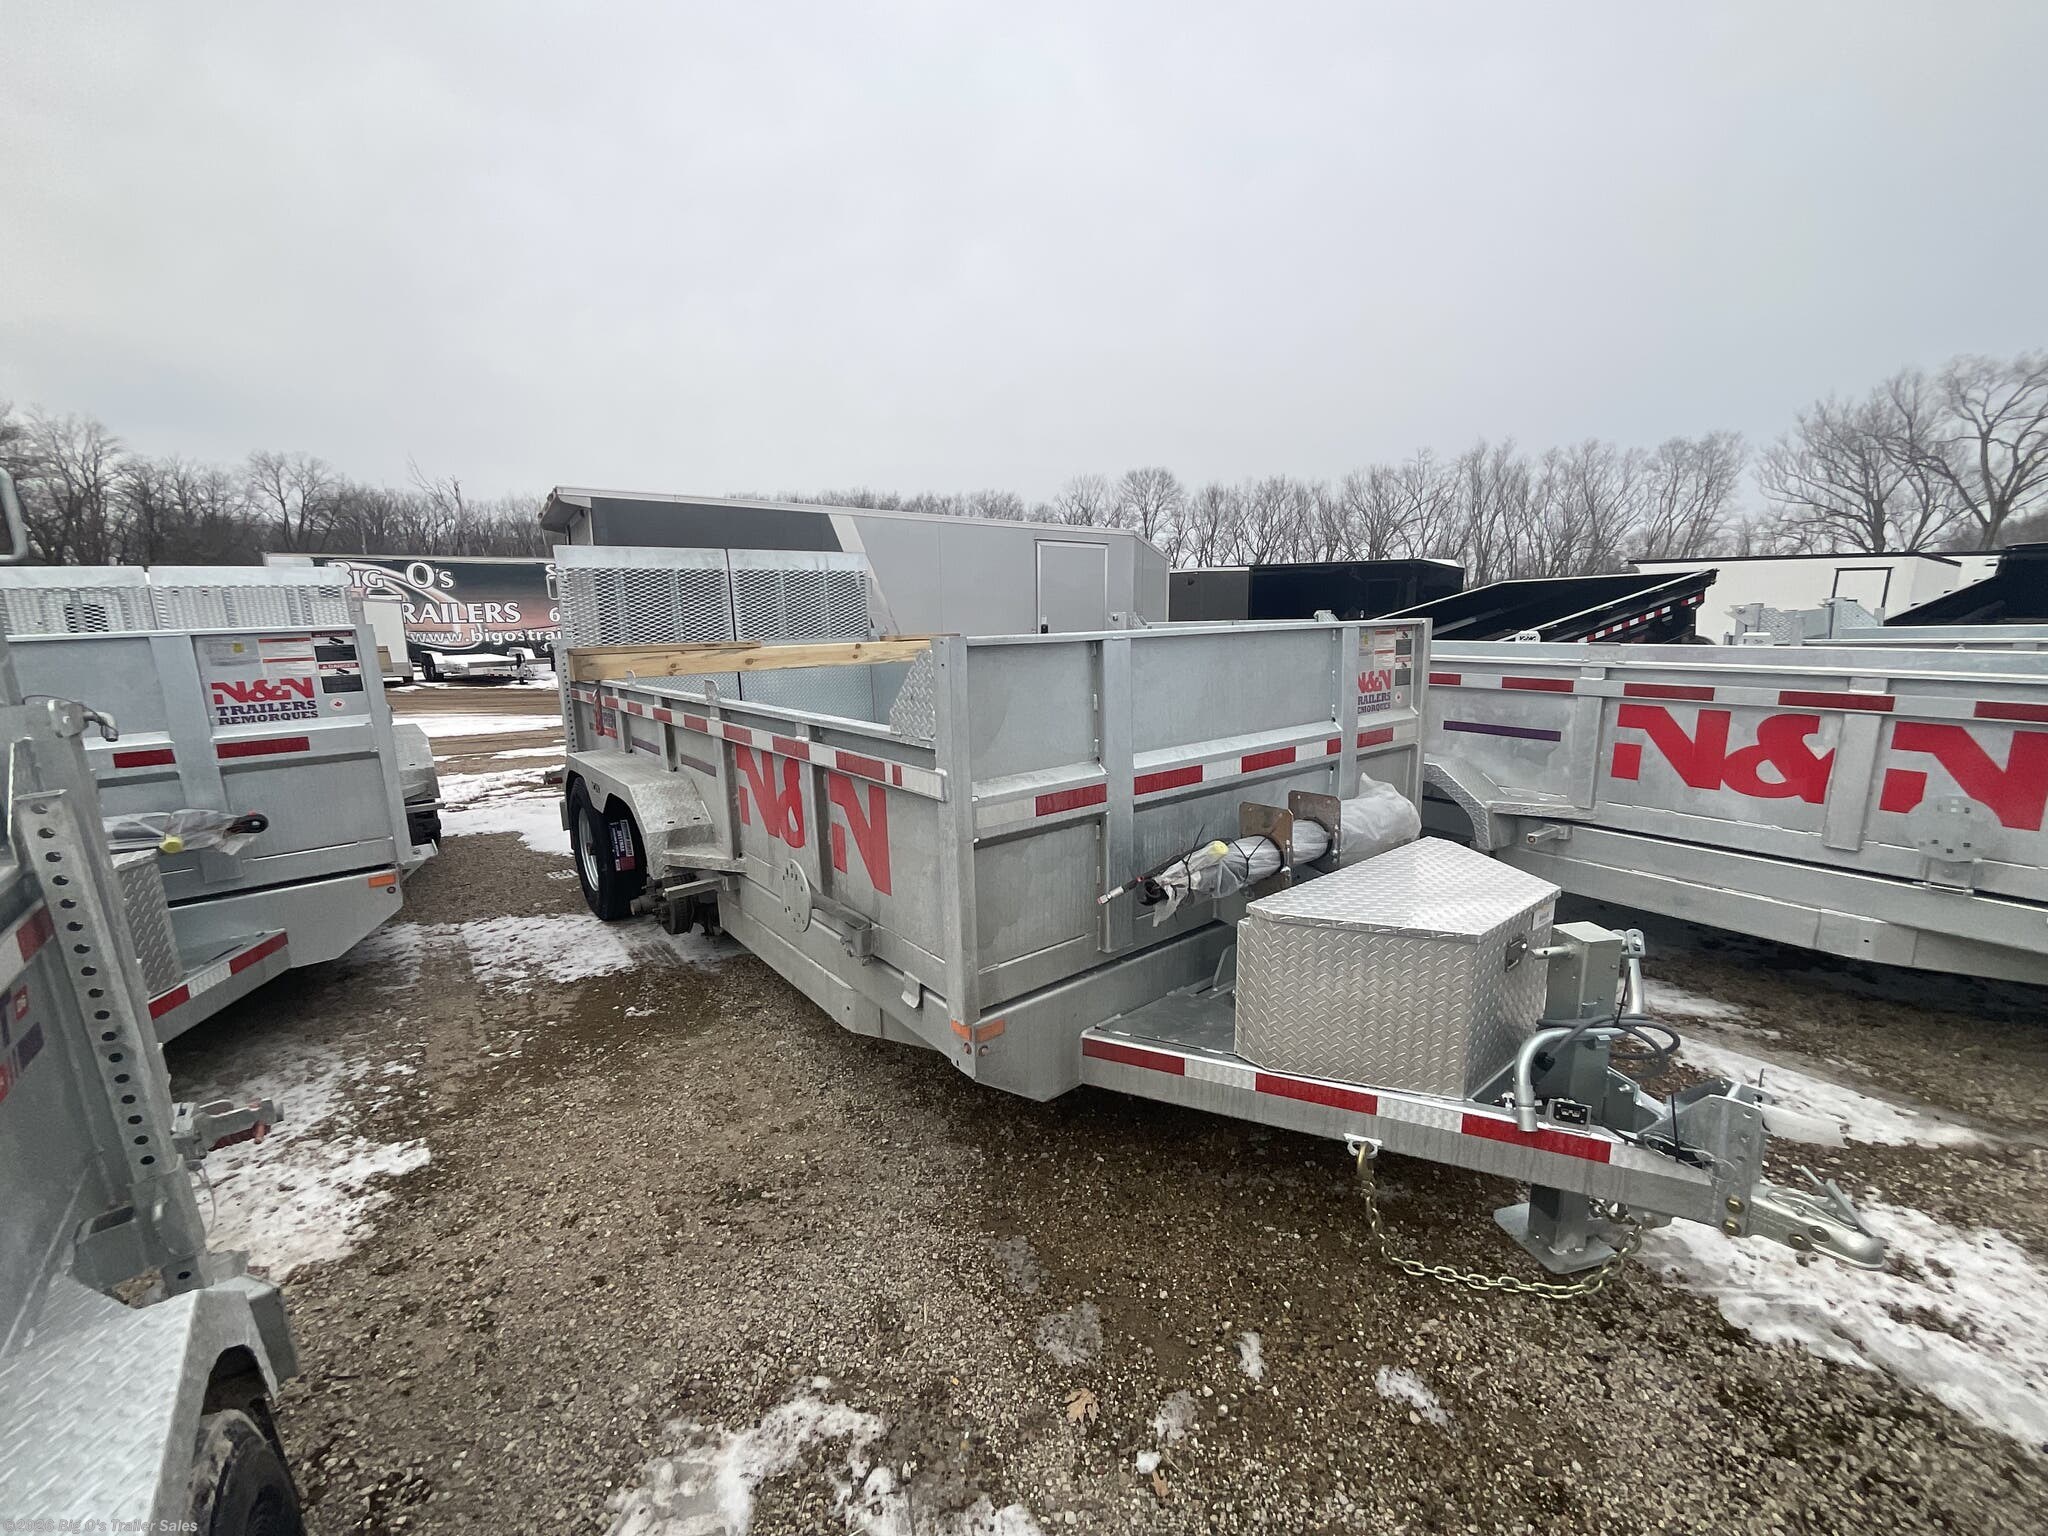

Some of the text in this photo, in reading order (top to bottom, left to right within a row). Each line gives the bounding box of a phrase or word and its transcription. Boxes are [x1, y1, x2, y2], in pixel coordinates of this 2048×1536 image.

[368, 594, 521, 625] RAILERS
[410, 628, 563, 645] www.bigostrai
[211, 677, 315, 705] N&N
[1358, 692, 1391, 705] RAILERS
[216, 700, 317, 716] TRAILERS
[1358, 702, 1391, 714] EMORQUES
[219, 711, 319, 726] REMORQUES
